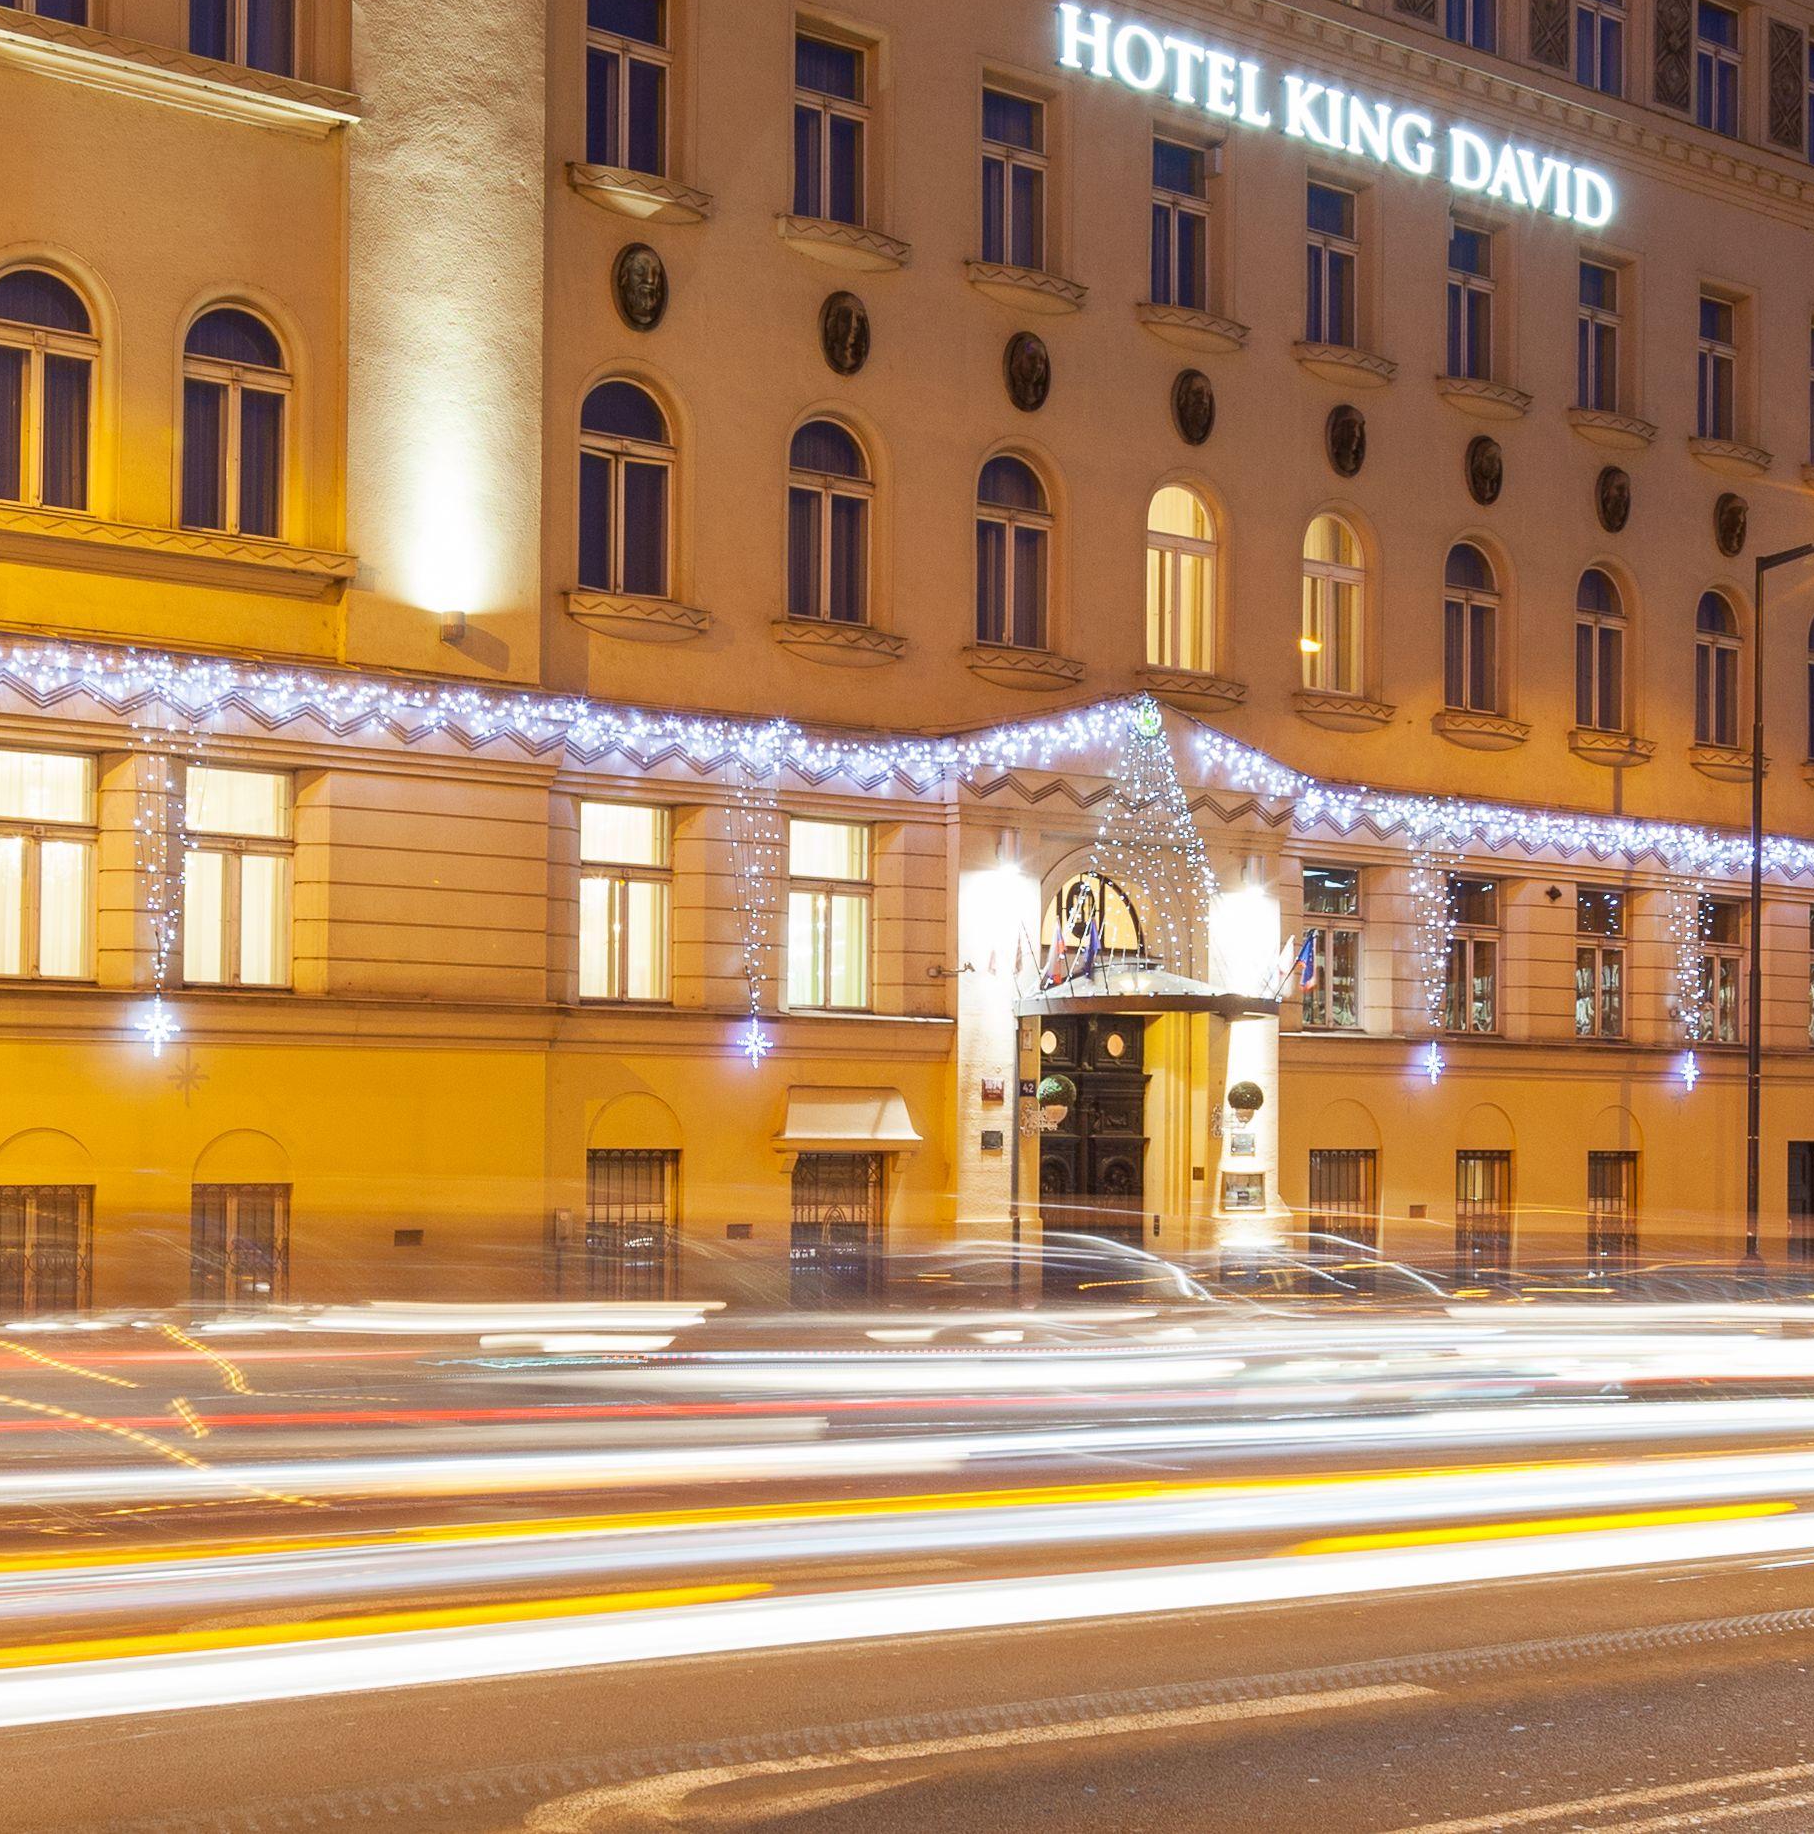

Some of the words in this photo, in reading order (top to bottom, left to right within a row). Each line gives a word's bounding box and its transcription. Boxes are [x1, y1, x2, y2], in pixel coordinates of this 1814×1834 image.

[1057, 2, 1271, 127] HOTEL
[1282, 73, 1435, 175] KING
[1448, 127, 1615, 228] DAVID
[1022, 1083, 1034, 1093] 42
